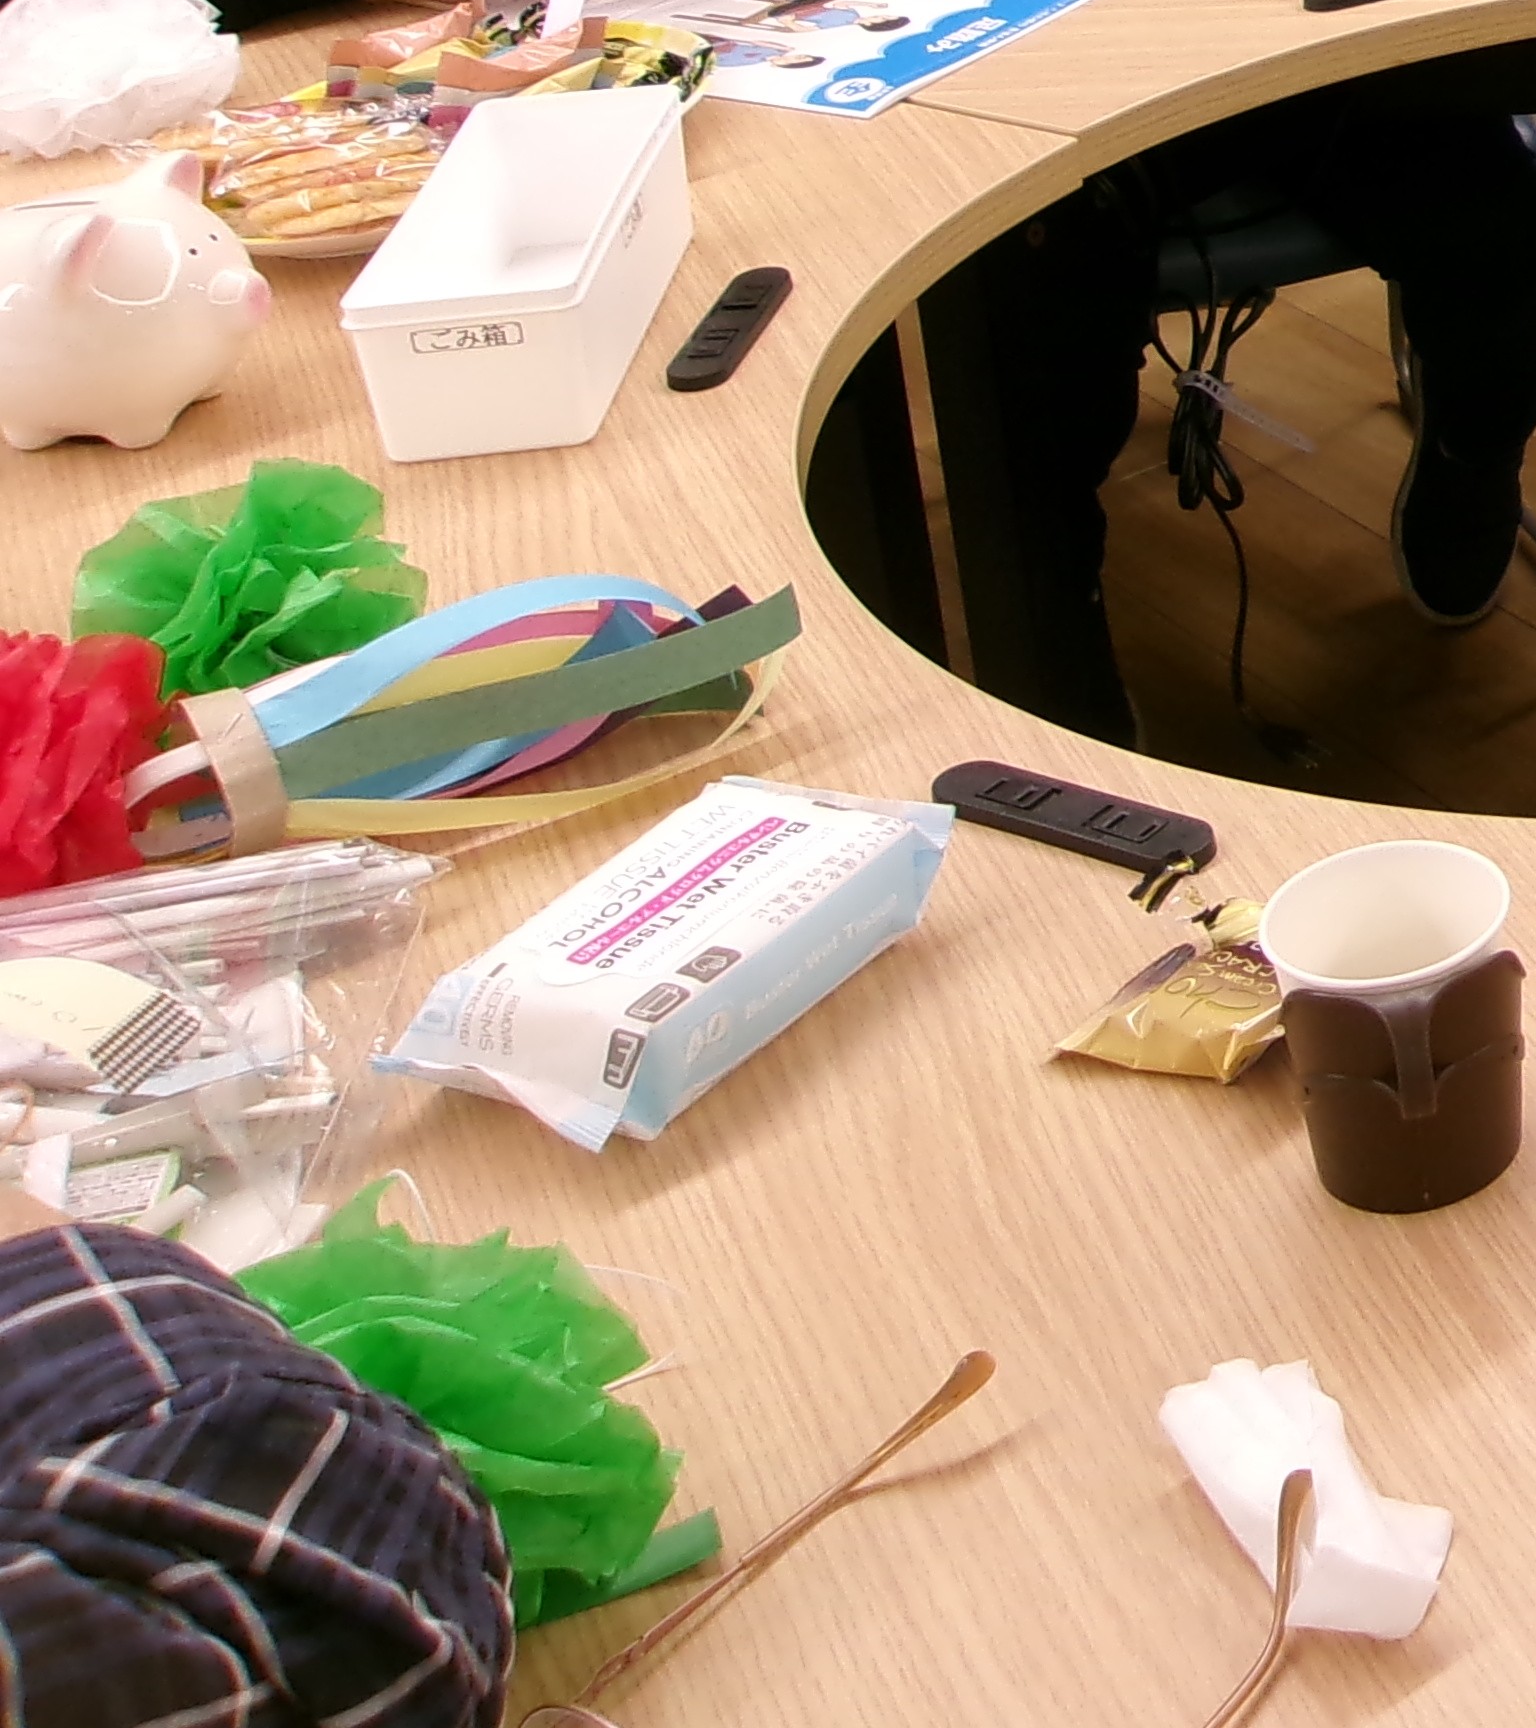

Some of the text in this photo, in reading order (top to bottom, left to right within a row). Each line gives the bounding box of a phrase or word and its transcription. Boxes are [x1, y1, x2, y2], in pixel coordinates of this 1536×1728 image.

[430, 323, 507, 350] ごみ箱
[547, 866, 667, 950] ALCOHOL
[594, 821, 810, 971] Buster Wet Tissue
